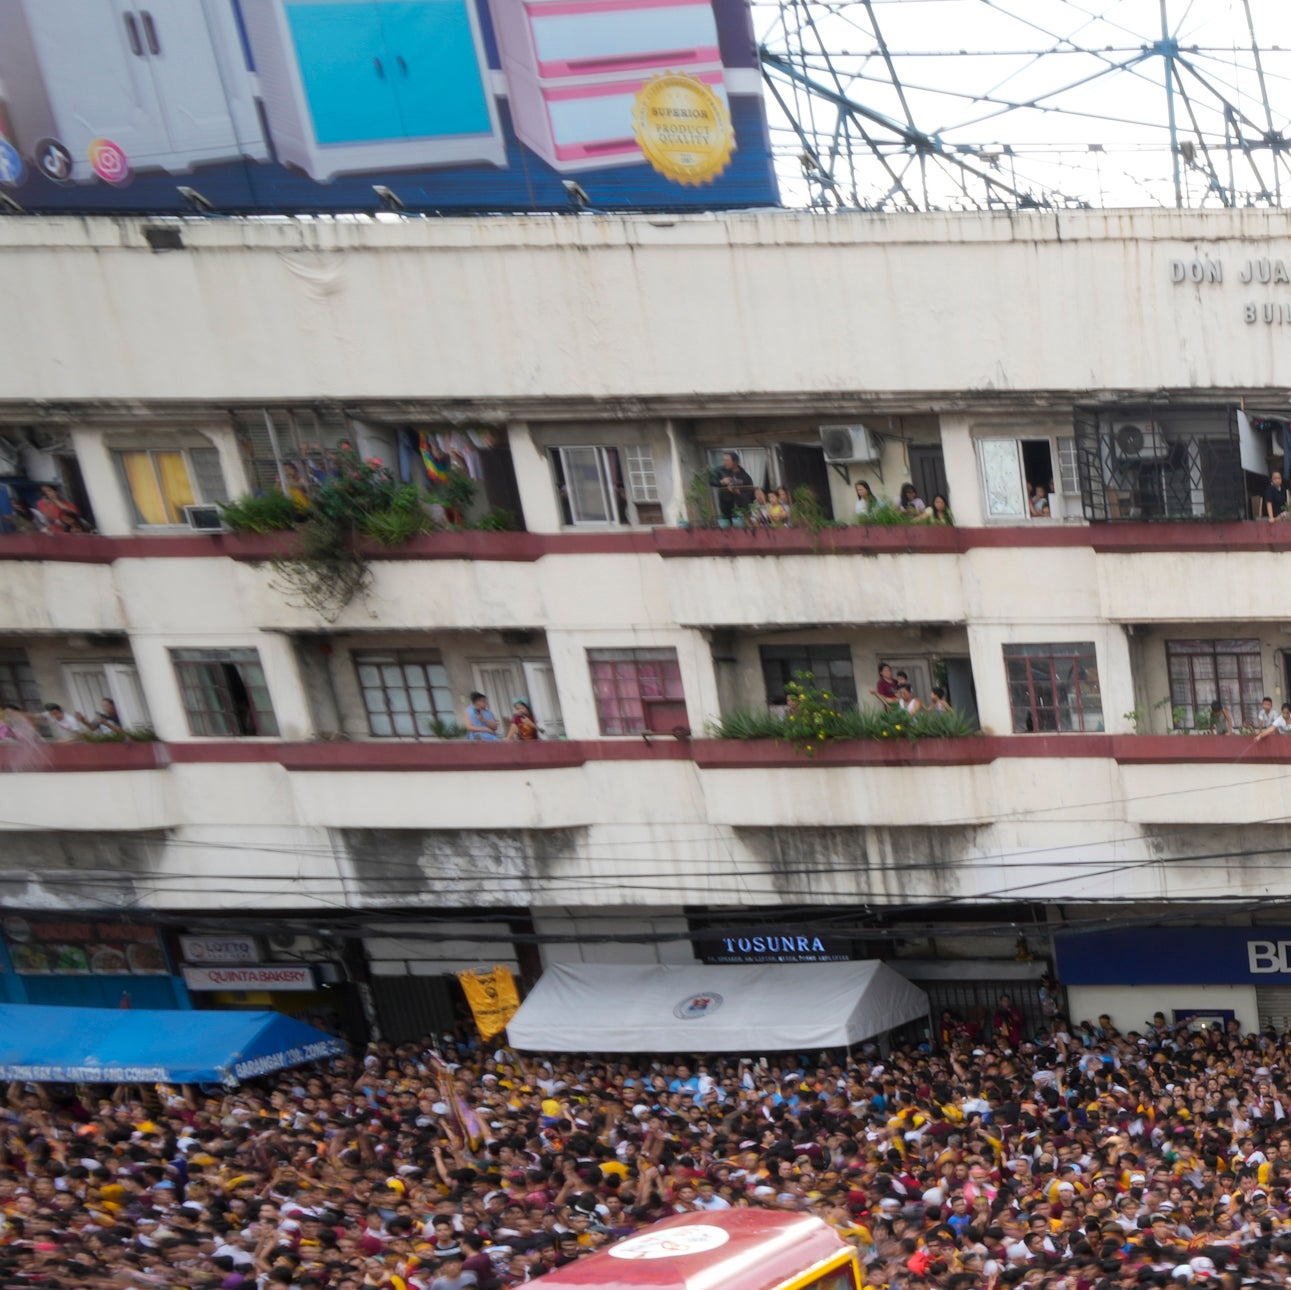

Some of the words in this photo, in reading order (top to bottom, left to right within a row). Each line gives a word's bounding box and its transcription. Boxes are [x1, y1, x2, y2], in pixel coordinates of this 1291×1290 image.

[651, 107, 709, 120] SUPERIOR
[655, 123, 710, 135] PRODUCT
[659, 133, 710, 146] QUALITY
[1169, 258, 1223, 285] DON
[205, 942, 250, 953] LOTTO
[722, 936, 826, 953] TOSUNRA
[207, 970, 258, 984] QUINTA
[259, 970, 306, 983] BAKERY
[234, 1051, 286, 1078] BARANGAY
[303, 1041, 329, 1060] ZONE
